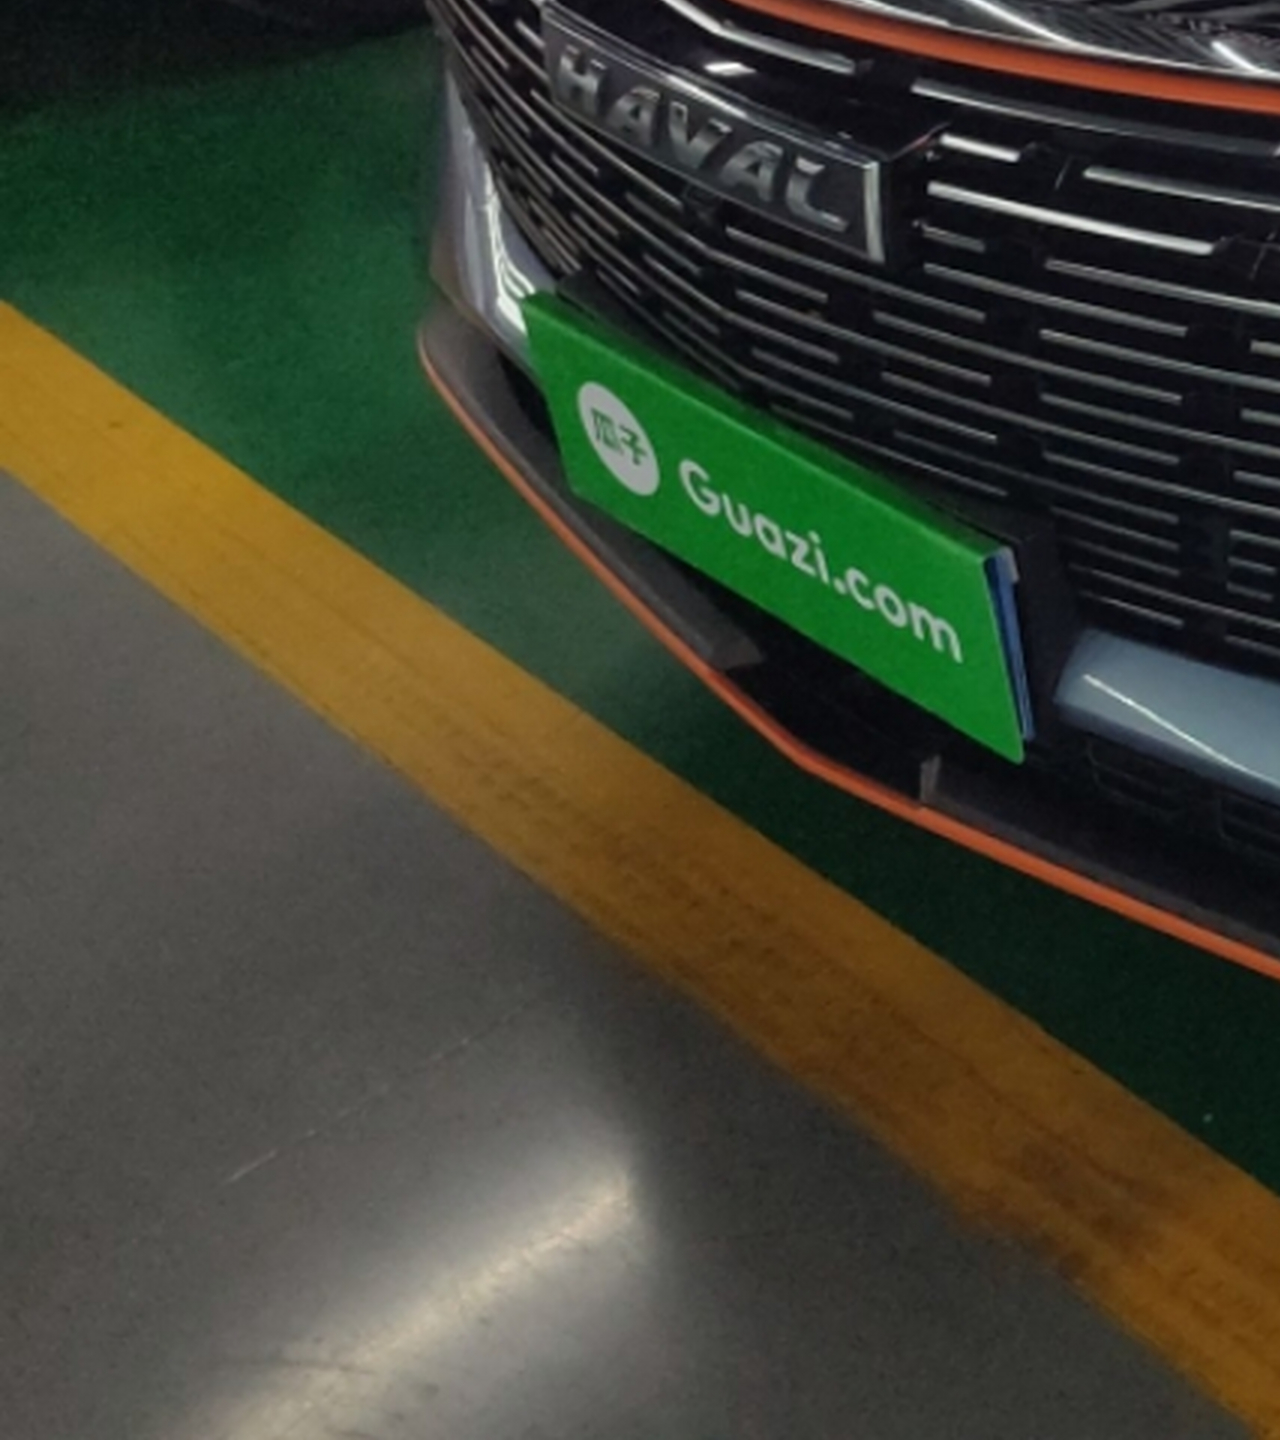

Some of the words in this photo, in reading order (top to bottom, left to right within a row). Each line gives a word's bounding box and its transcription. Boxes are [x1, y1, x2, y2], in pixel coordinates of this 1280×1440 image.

[556, 44, 851, 234] HAVAL
[590, 406, 648, 467] 瓜子
[679, 459, 964, 664] Guazi.com
